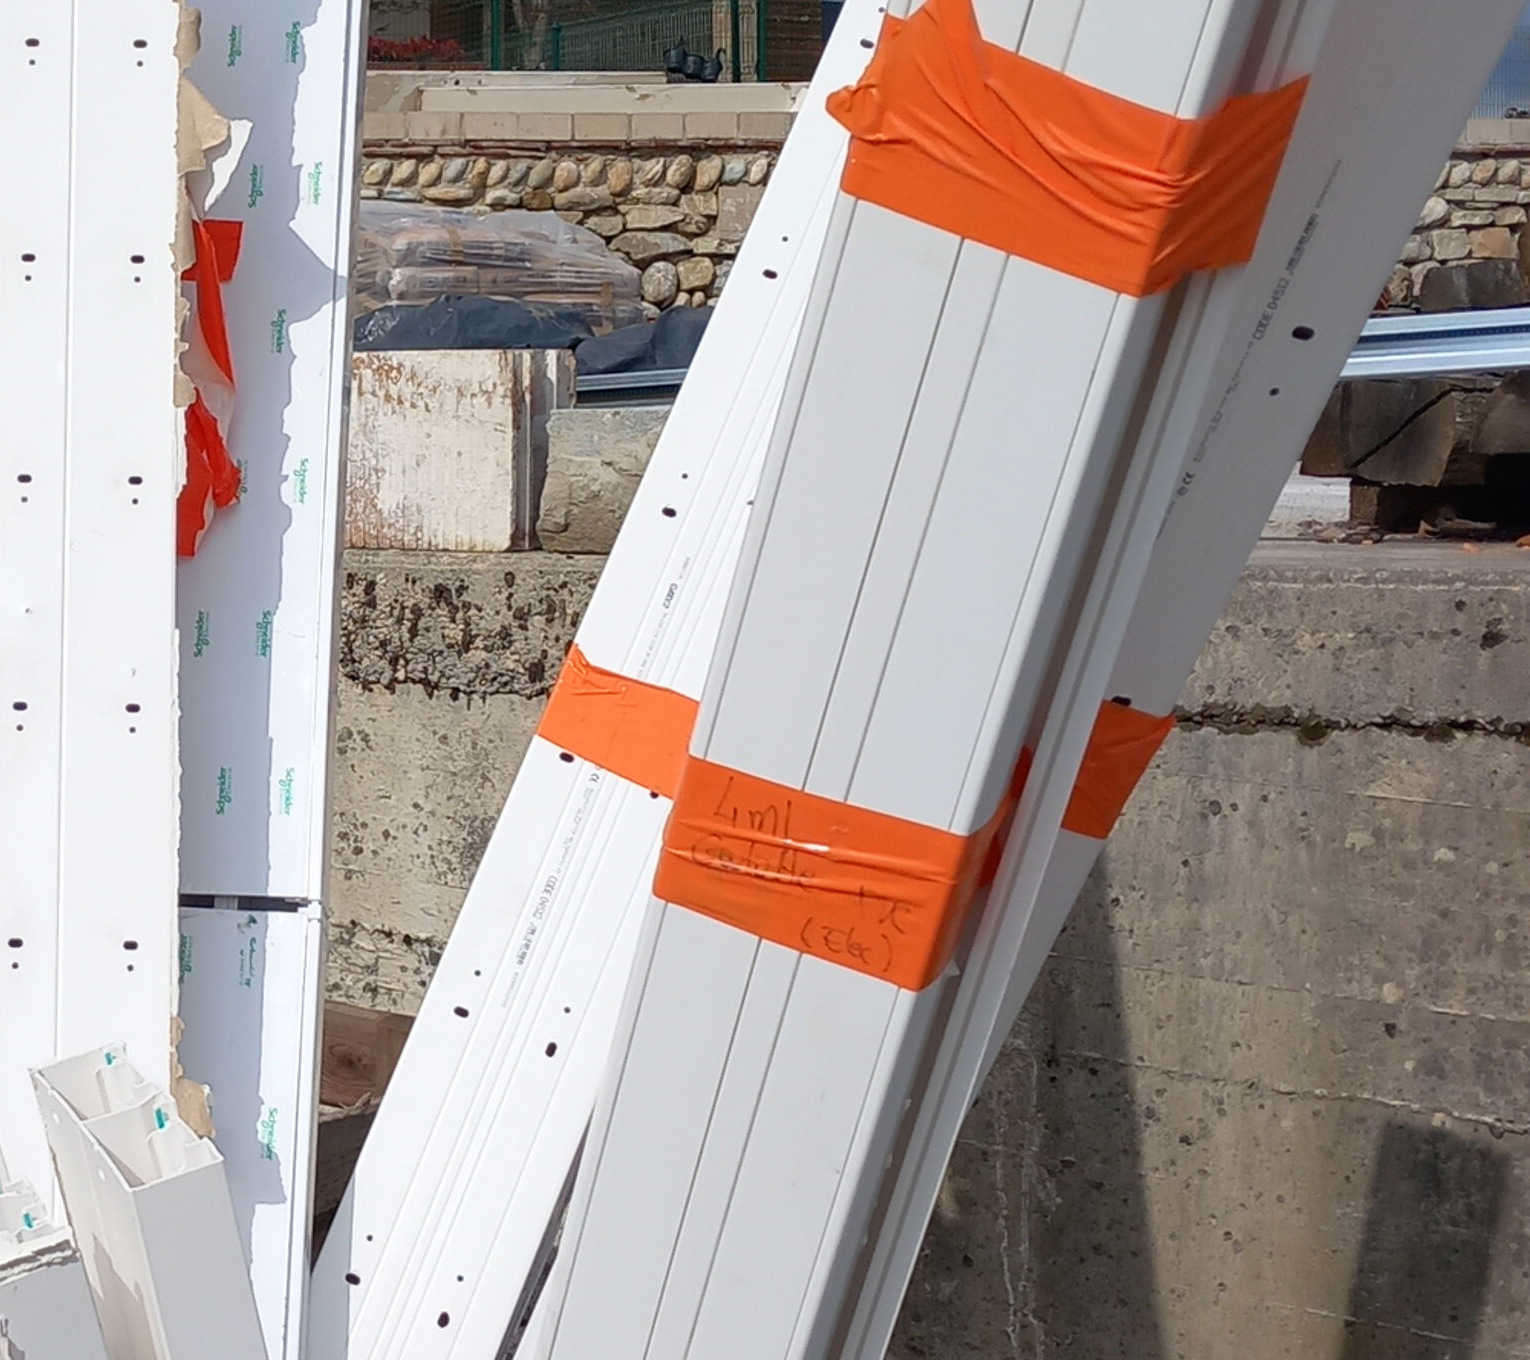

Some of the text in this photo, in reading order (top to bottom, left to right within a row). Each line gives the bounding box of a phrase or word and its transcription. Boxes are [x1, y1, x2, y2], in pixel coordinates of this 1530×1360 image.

[227, 24, 242, 68] Schneider
[285, 20, 301, 64] Schneider
[248, 164, 264, 209] Schneider
[308, 160, 323, 205] Schneider
[271, 308, 287, 354] Schneider
[293, 456, 309, 504] Schneider
[194, 609, 210, 658] Schneider
[256, 609, 272, 658] Schneider
[215, 765, 232, 816] Schneider
[279, 767, 295, 817] Schneider
